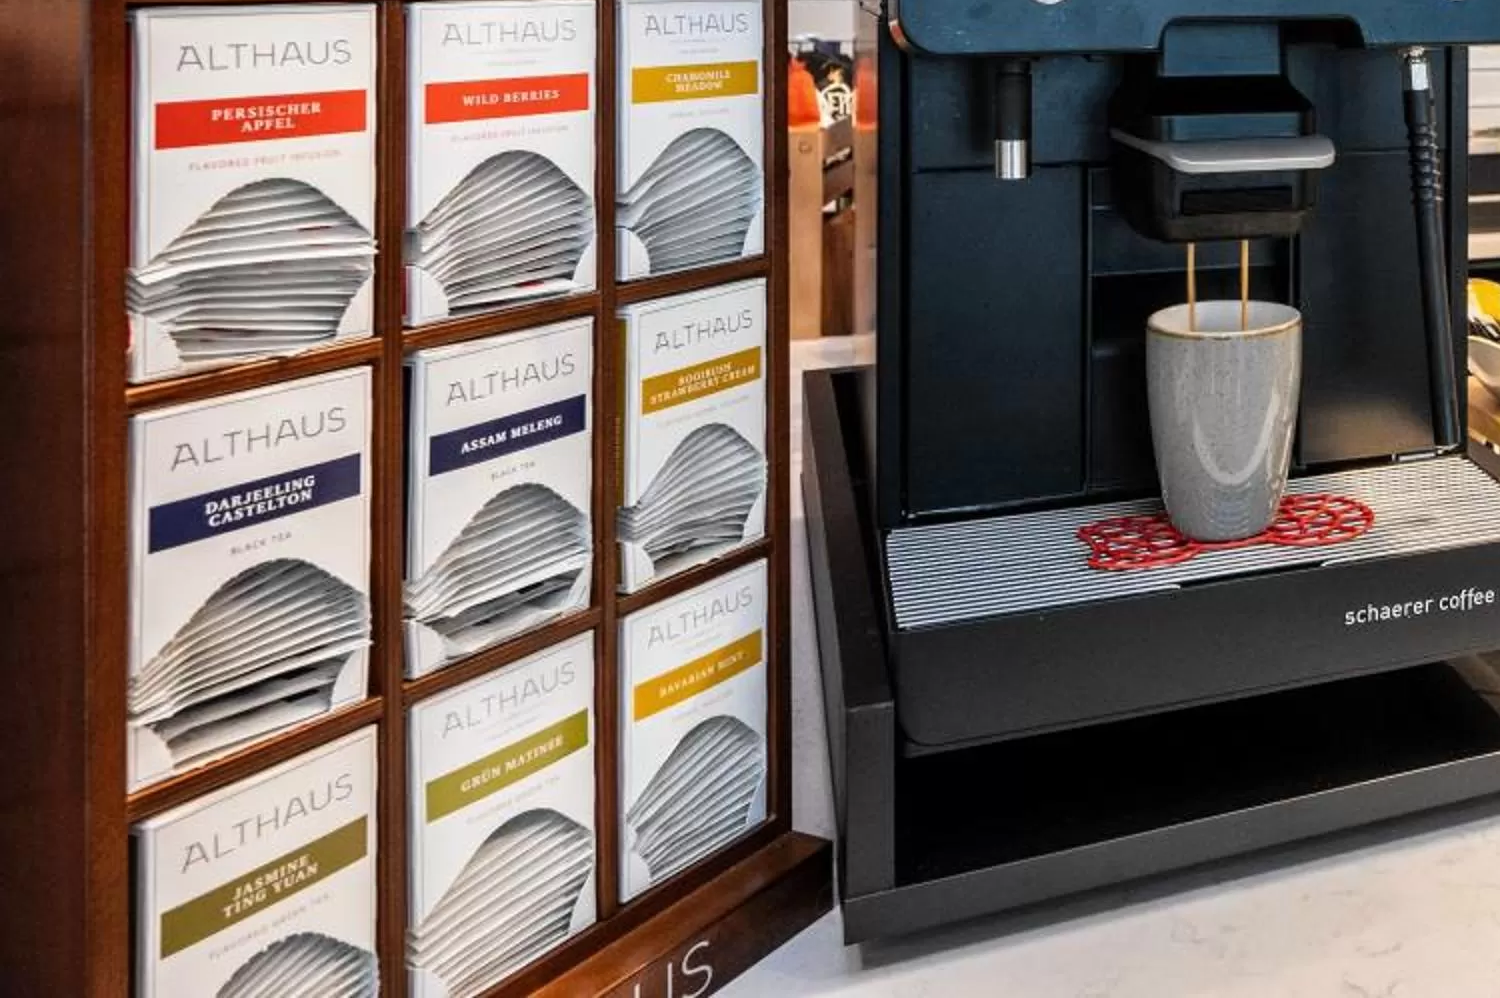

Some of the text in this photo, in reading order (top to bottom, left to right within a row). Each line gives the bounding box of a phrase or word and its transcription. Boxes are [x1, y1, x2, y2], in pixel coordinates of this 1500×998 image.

[442, 18, 577, 46] ALTHAUS
[644, 13, 750, 37] ALTHAUS
[177, 39, 352, 72] ALTHAUS
[211, 101, 321, 121] PERSISCHER
[462, 89, 560, 106] WILD BERRIES
[240, 117, 296, 133] APFEL
[654, 309, 753, 354] ALTHAUS
[447, 353, 576, 405] ALTHAUS
[171, 407, 347, 471] ALTHAUS
[461, 414, 563, 454] ASSAM MELENG
[205, 475, 316, 516] DARJEELING
[208, 488, 313, 527] CASTELTON
[230, 531, 292, 555] BLACK TEA
[647, 585, 753, 650] ALTHAUS
[1344, 599, 1434, 626] schaerer
[1439, 587, 1495, 611] coffee
[442, 661, 576, 740] ALTHAUS
[460, 767, 501, 793] GRÜN
[180, 773, 353, 875] ALTHAUS
[222, 862, 319, 919] TING YUAN
[231, 853, 312, 901] JASMINE
